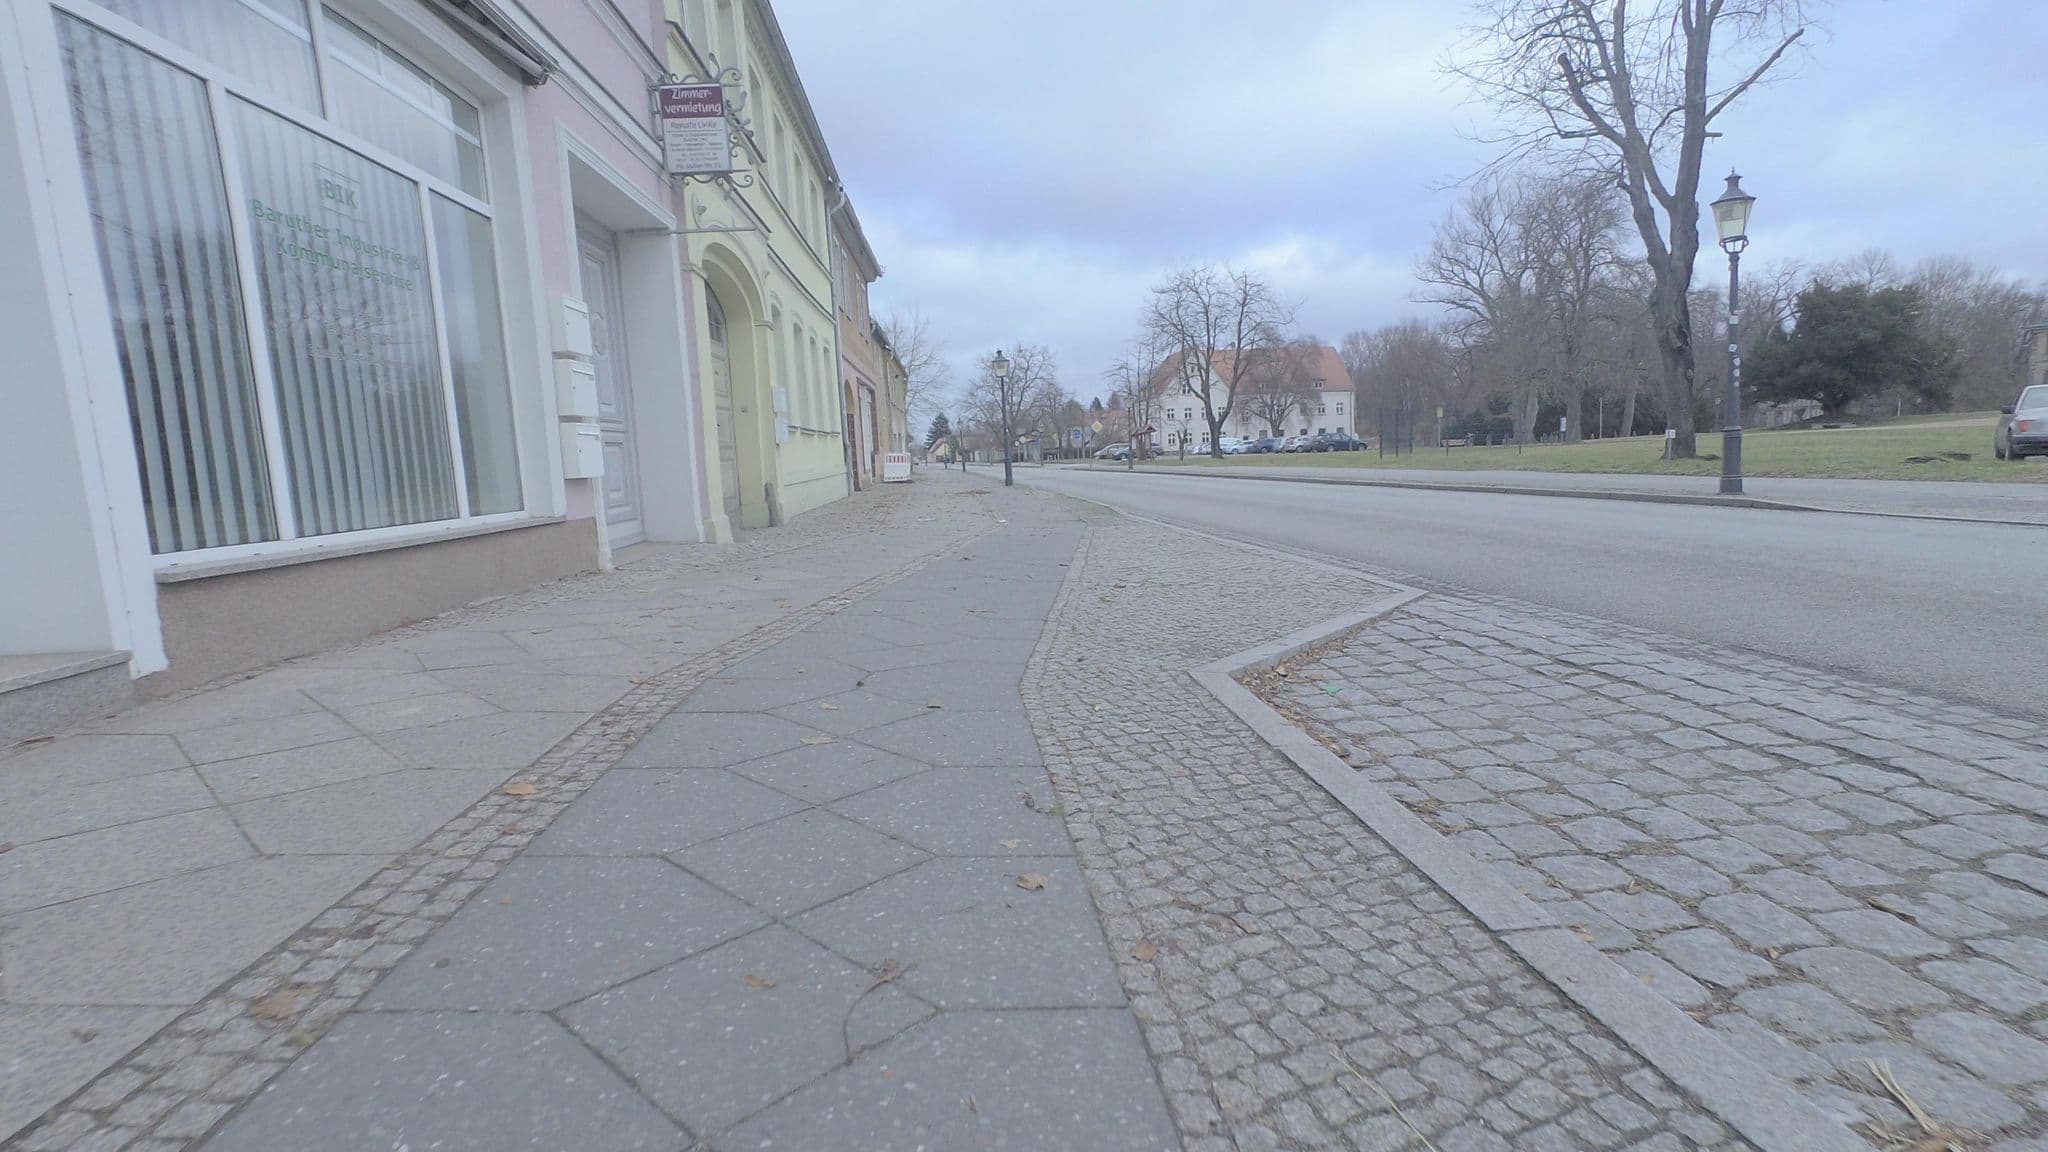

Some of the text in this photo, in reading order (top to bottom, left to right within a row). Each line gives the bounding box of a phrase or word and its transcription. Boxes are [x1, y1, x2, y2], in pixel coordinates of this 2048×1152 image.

[672, 88, 712, 99] Zimmer-
[664, 101, 721, 115] vermietung
[323, 179, 357, 209] BIK
[253, 200, 330, 239] Baruther
